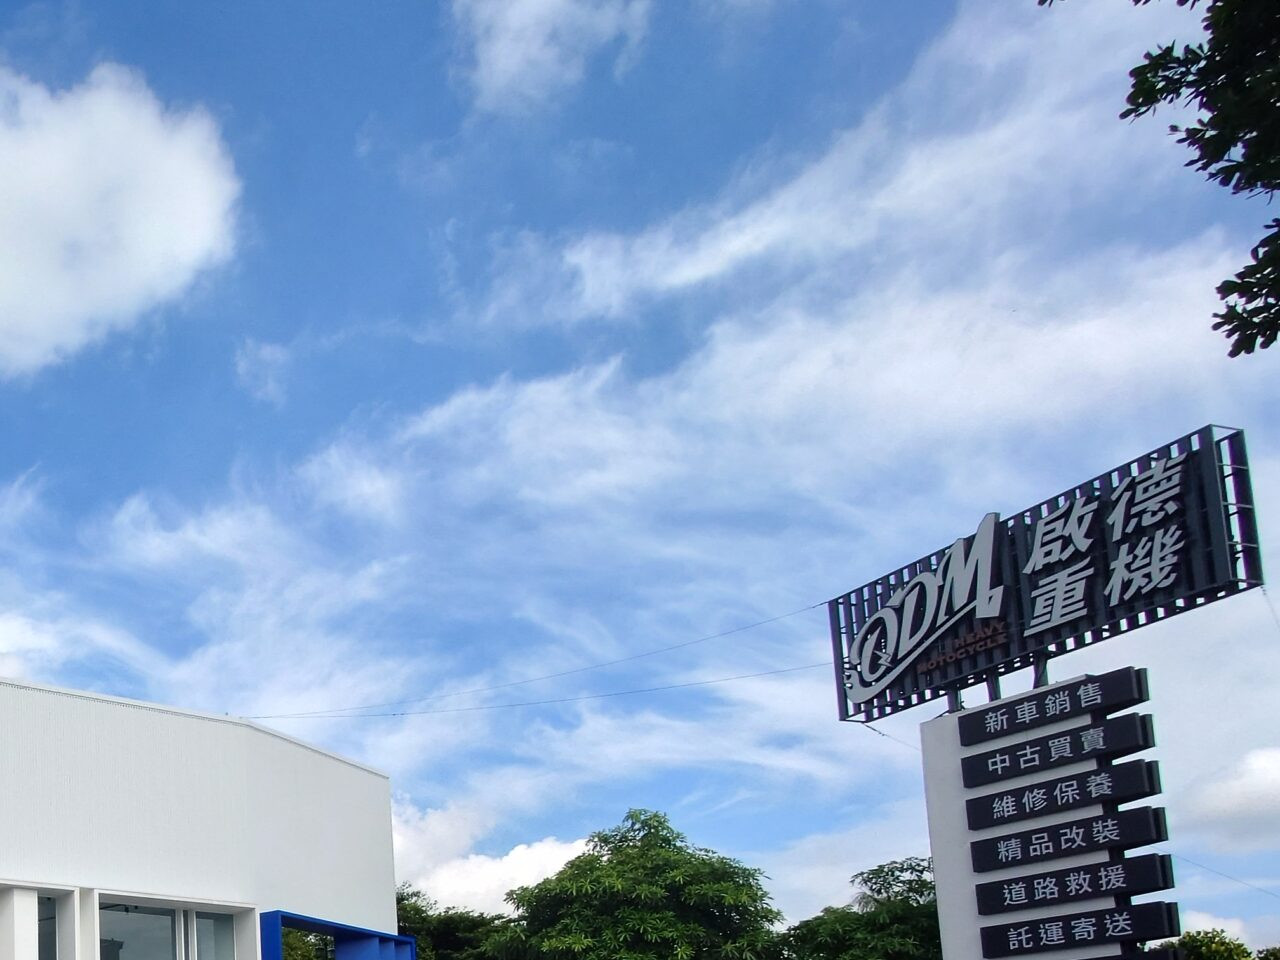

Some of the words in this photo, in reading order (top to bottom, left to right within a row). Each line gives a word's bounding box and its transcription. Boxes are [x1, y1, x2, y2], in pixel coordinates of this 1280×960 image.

[1022, 452, 1188, 575] 啟德
[1023, 524, 1186, 637] 重機
[954, 620, 1006, 648] HEAVY
[984, 681, 1103, 733] 新車銷售
[987, 726, 1106, 775] 中古買賣
[992, 772, 1114, 820] 維修保養
[997, 818, 1120, 863] 精品改裝
[1003, 864, 1127, 907] 道路救援
[1007, 911, 1133, 951] 託運寄送
